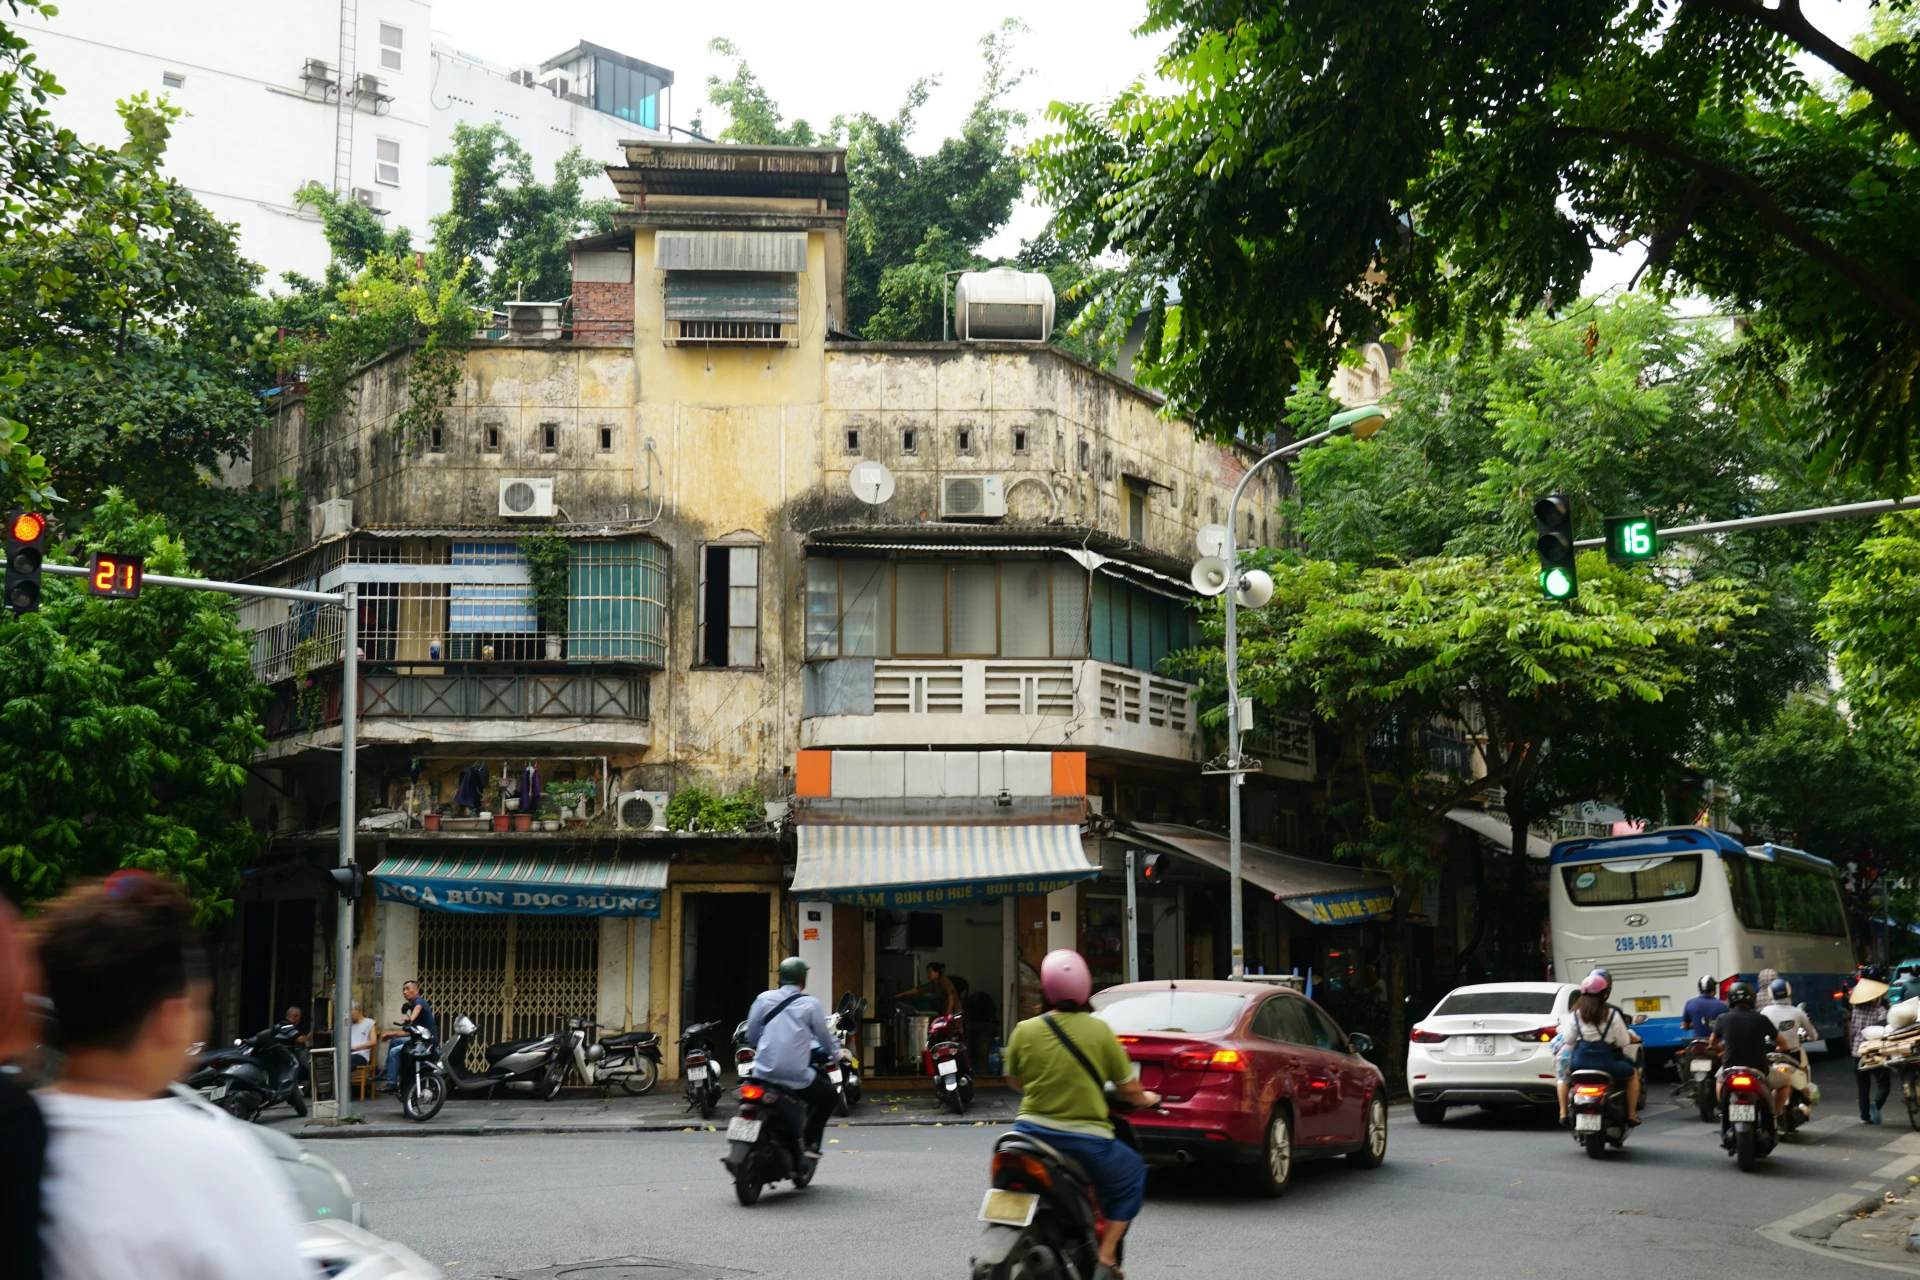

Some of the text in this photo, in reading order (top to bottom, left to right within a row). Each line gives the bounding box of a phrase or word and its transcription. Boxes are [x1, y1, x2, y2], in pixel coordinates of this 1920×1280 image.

[1624, 523, 1650, 554] 16
[96, 561, 134, 590] 21
[379, 882, 657, 911] NGA BÚN DỌC MÙNG
[895, 889, 923, 905] BÚN
[1615, 933, 1674, 952] 29B-609.21
